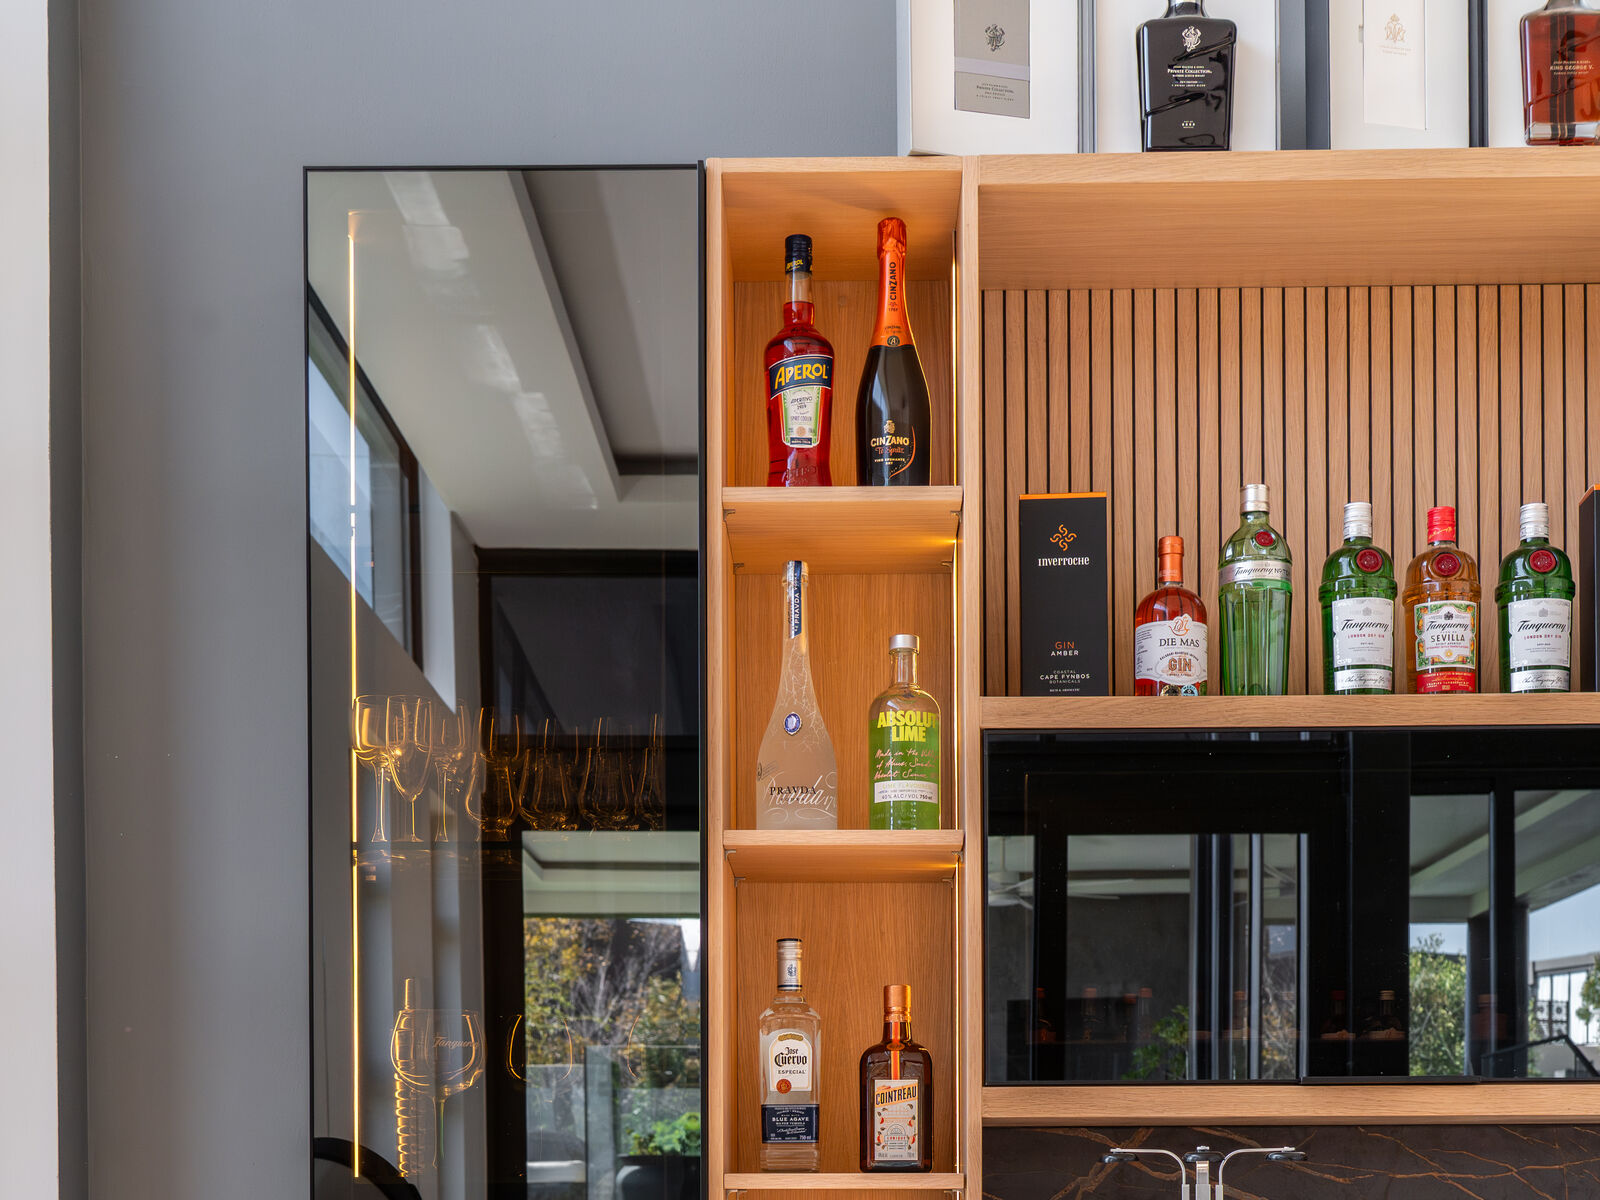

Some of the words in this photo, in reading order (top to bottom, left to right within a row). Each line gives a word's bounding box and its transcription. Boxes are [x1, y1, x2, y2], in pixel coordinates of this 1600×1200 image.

[889, 262, 898, 301] CINZANO
[774, 363, 829, 391] APEROL
[870, 435, 910, 448] CINZANO
[1234, 566, 1274, 577] Tanqueray
[1340, 619, 1390, 632] Tanqueray
[1426, 620, 1470, 632] Tanqueray
[1517, 620, 1567, 633] Tanqueray
[1159, 637, 1178, 647] DIE
[1180, 637, 1201, 648] MAS
[1430, 634, 1466, 643] SEVILLA
[1055, 641, 1076, 650] GIN
[1050, 649, 1080, 657] AMBER
[1168, 657, 1192, 672] GIN
[876, 710, 937, 729] ABSOLUT
[891, 726, 927, 742] LIME
[769, 785, 817, 796] PRAVDA
[784, 1046, 799, 1055] Jose
[774, 1052, 807, 1067] Cuervo
[875, 1085, 917, 1106] COINTREAU
